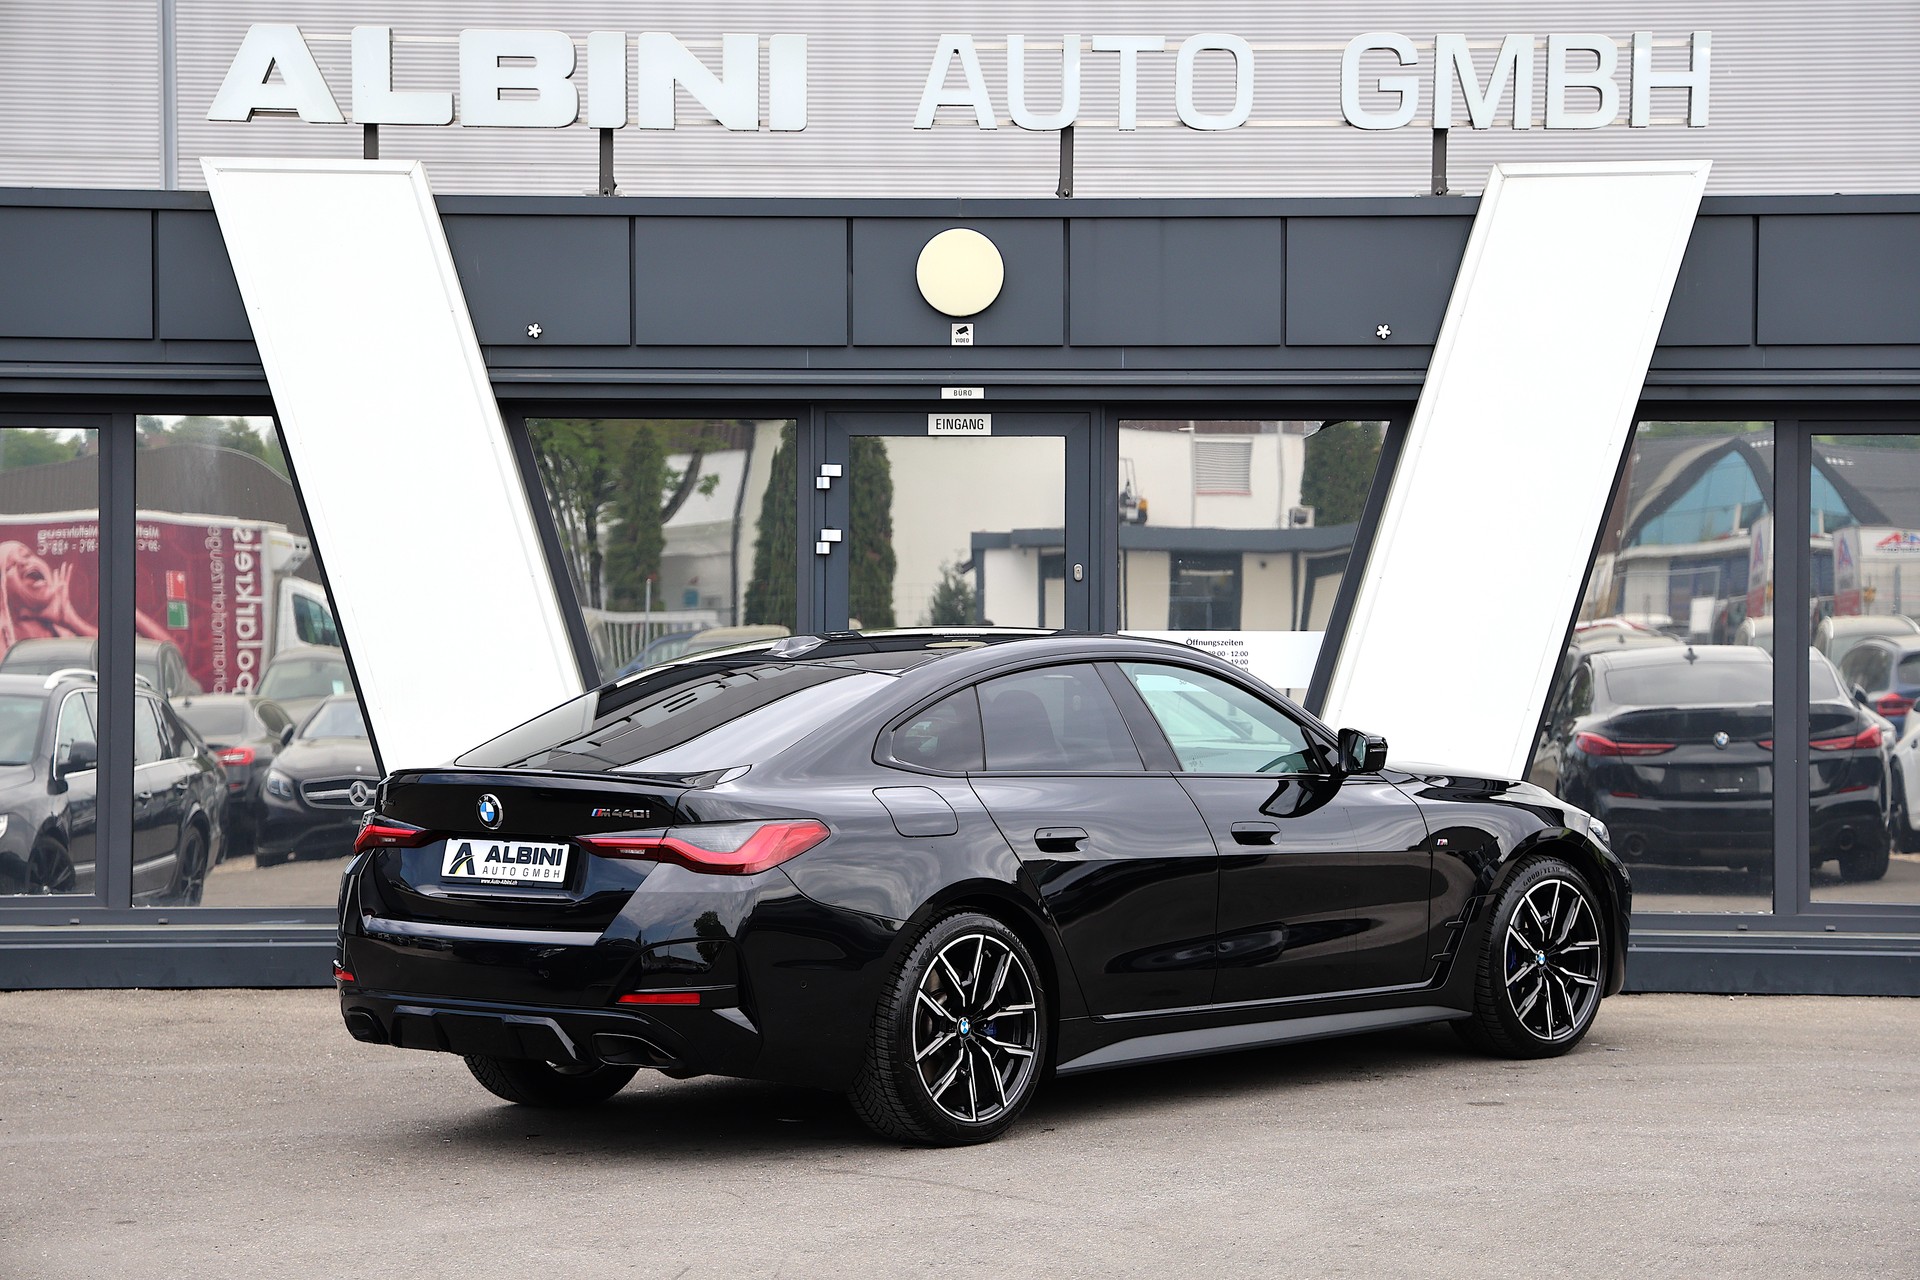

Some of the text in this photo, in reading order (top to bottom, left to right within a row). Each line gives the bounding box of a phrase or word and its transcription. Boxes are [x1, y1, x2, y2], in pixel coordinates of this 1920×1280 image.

[206, 24, 1713, 132] ALBINI AUTO GMBH
[953, 389, 973, 397] BÜRO
[935, 418, 985, 430] EINGANG
[1185, 637, 1244, 647] Öffnungszeiten
[600, 808, 650, 819] M440i
[484, 845, 564, 867] ALBINI
[482, 865, 561, 879] AUTO GMBH
